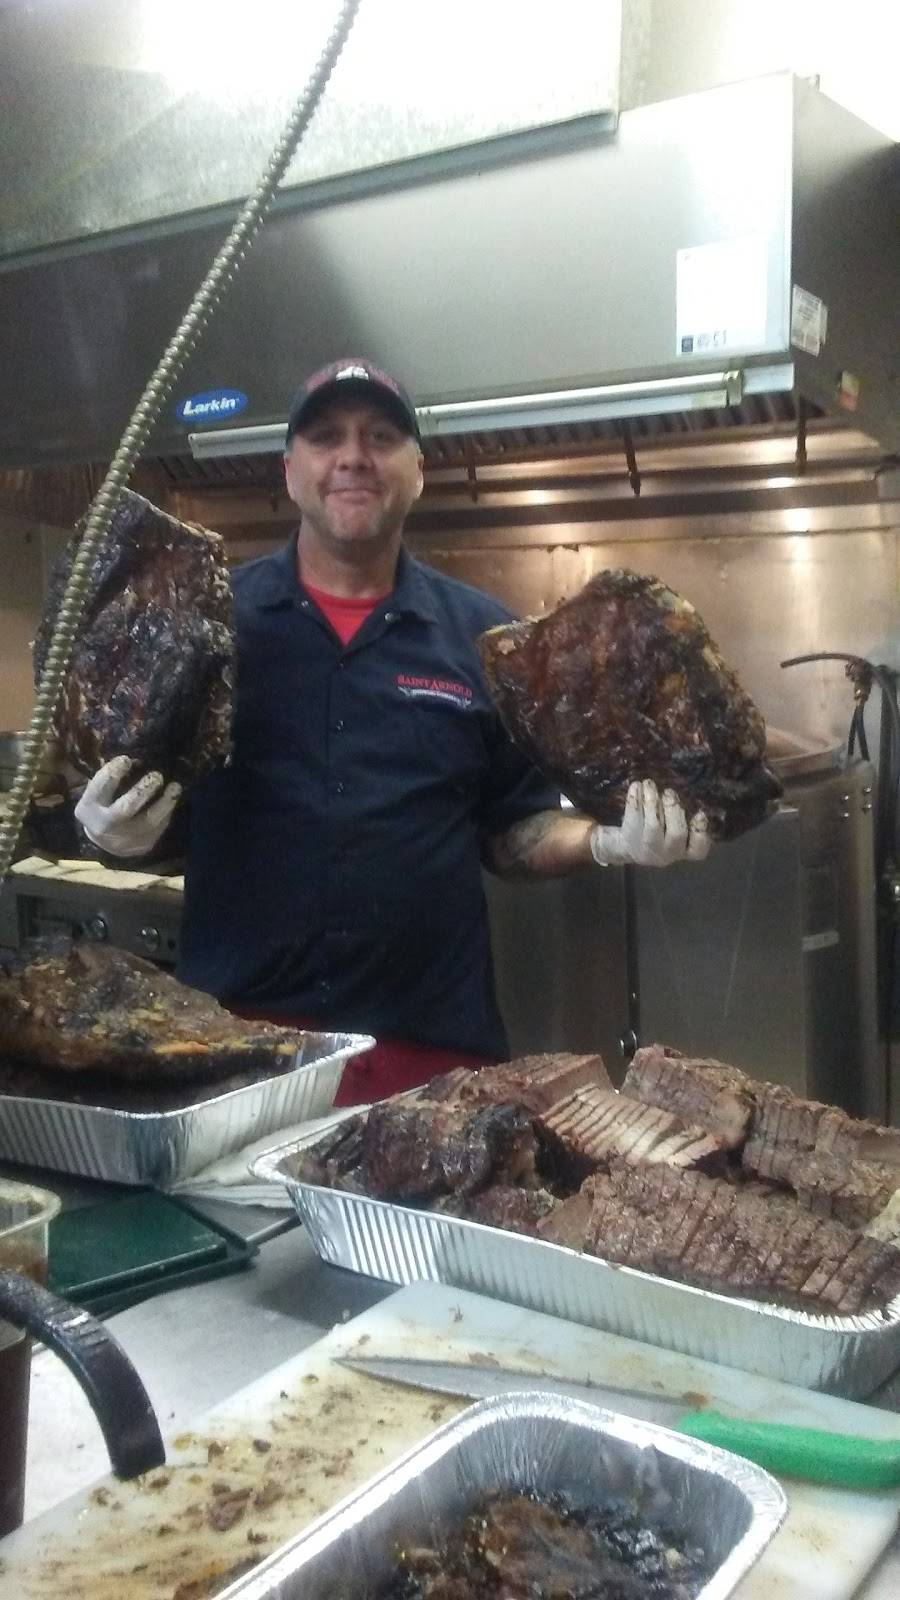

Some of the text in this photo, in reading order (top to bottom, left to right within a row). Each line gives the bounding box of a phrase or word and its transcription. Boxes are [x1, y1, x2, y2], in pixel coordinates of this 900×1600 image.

[182, 397, 236, 417] Larkin
[397, 674, 431, 688] SAINT
[431, 679, 473, 698] ARNOLD
